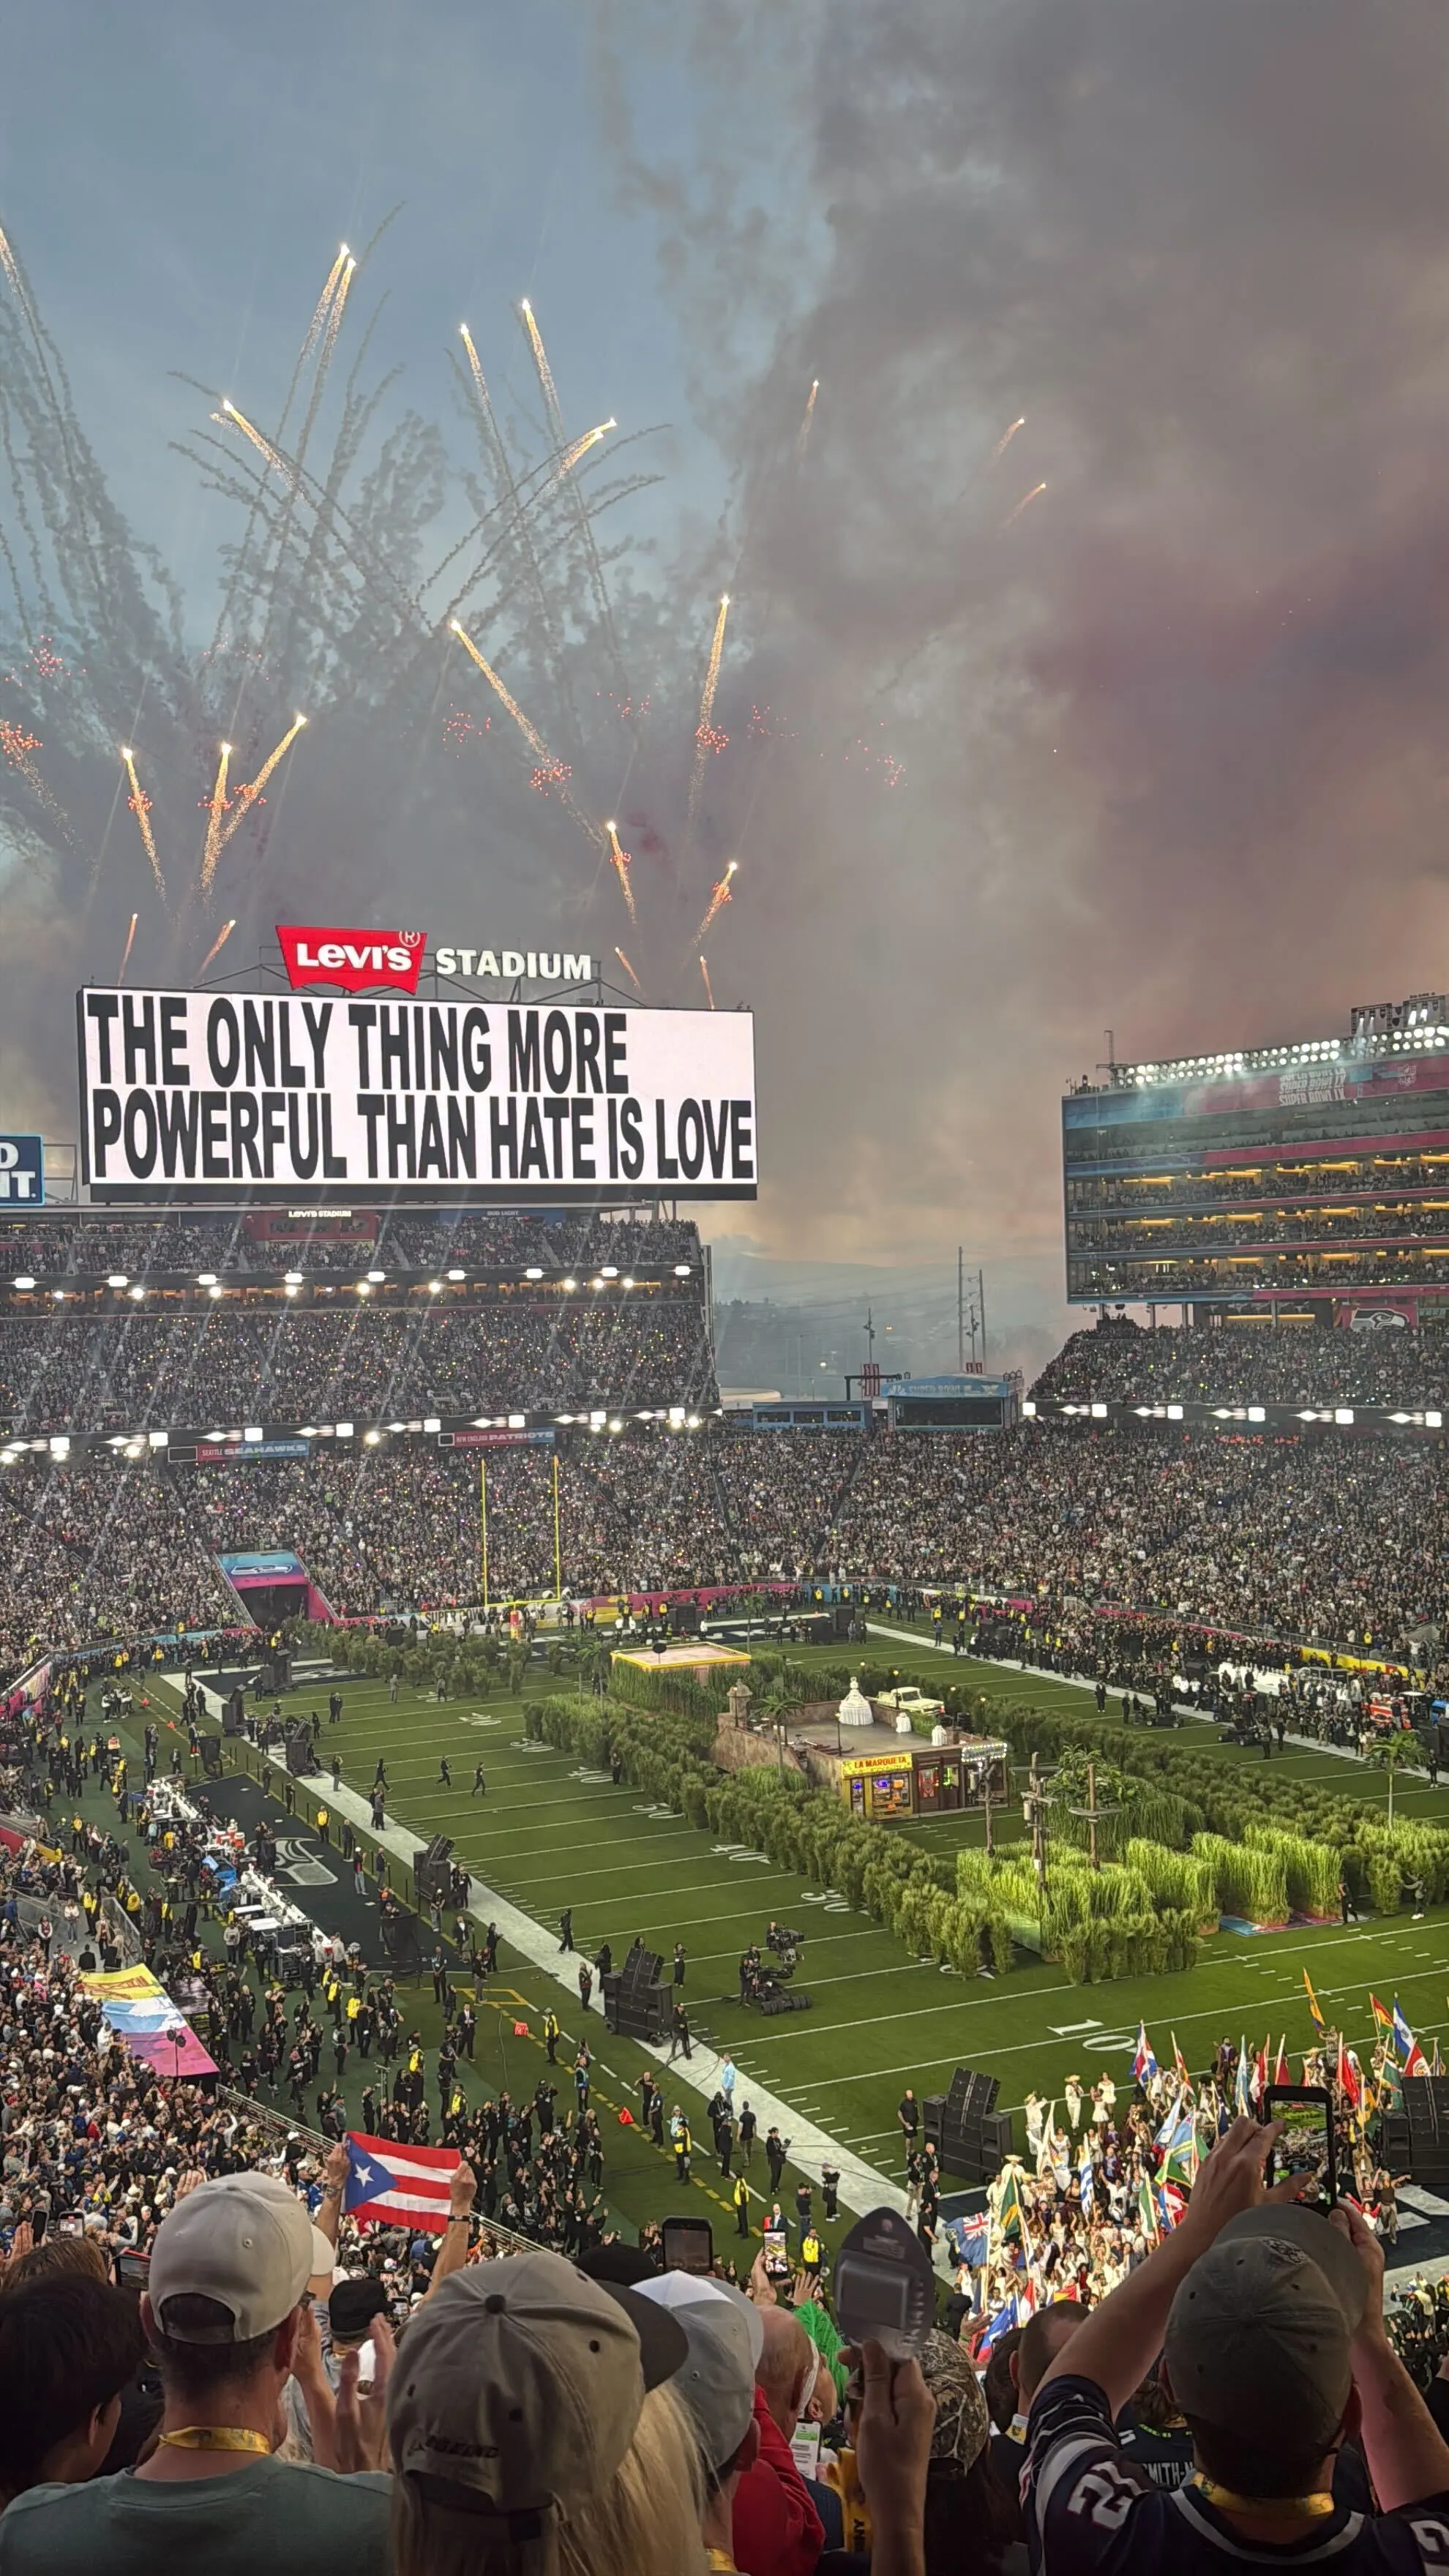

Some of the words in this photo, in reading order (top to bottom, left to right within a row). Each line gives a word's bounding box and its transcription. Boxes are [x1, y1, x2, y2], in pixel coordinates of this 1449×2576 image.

[435, 948, 593, 981] STADIUM
[86, 993, 190, 1085] THE
[207, 997, 333, 1088] ONLY
[348, 1003, 492, 1093] THING
[507, 1009, 629, 1094] MORE
[93, 1088, 347, 1179] POWERFUL
[357, 1093, 476, 1178] THAN
[490, 1096, 596, 1179] HATE
[607, 1097, 644, 1180] IS
[656, 1098, 754, 1180] LOVE
[318, 1210, 352, 1218] STADIUM
[489, 1431, 555, 1441] PATRIOTS
[202, 1448, 223, 1456] SEATTLE
[224, 1444, 307, 1456] SEAHAWKS
[854, 1760, 864, 1769] LA
[865, 1756, 907, 1767] MARQUETA
